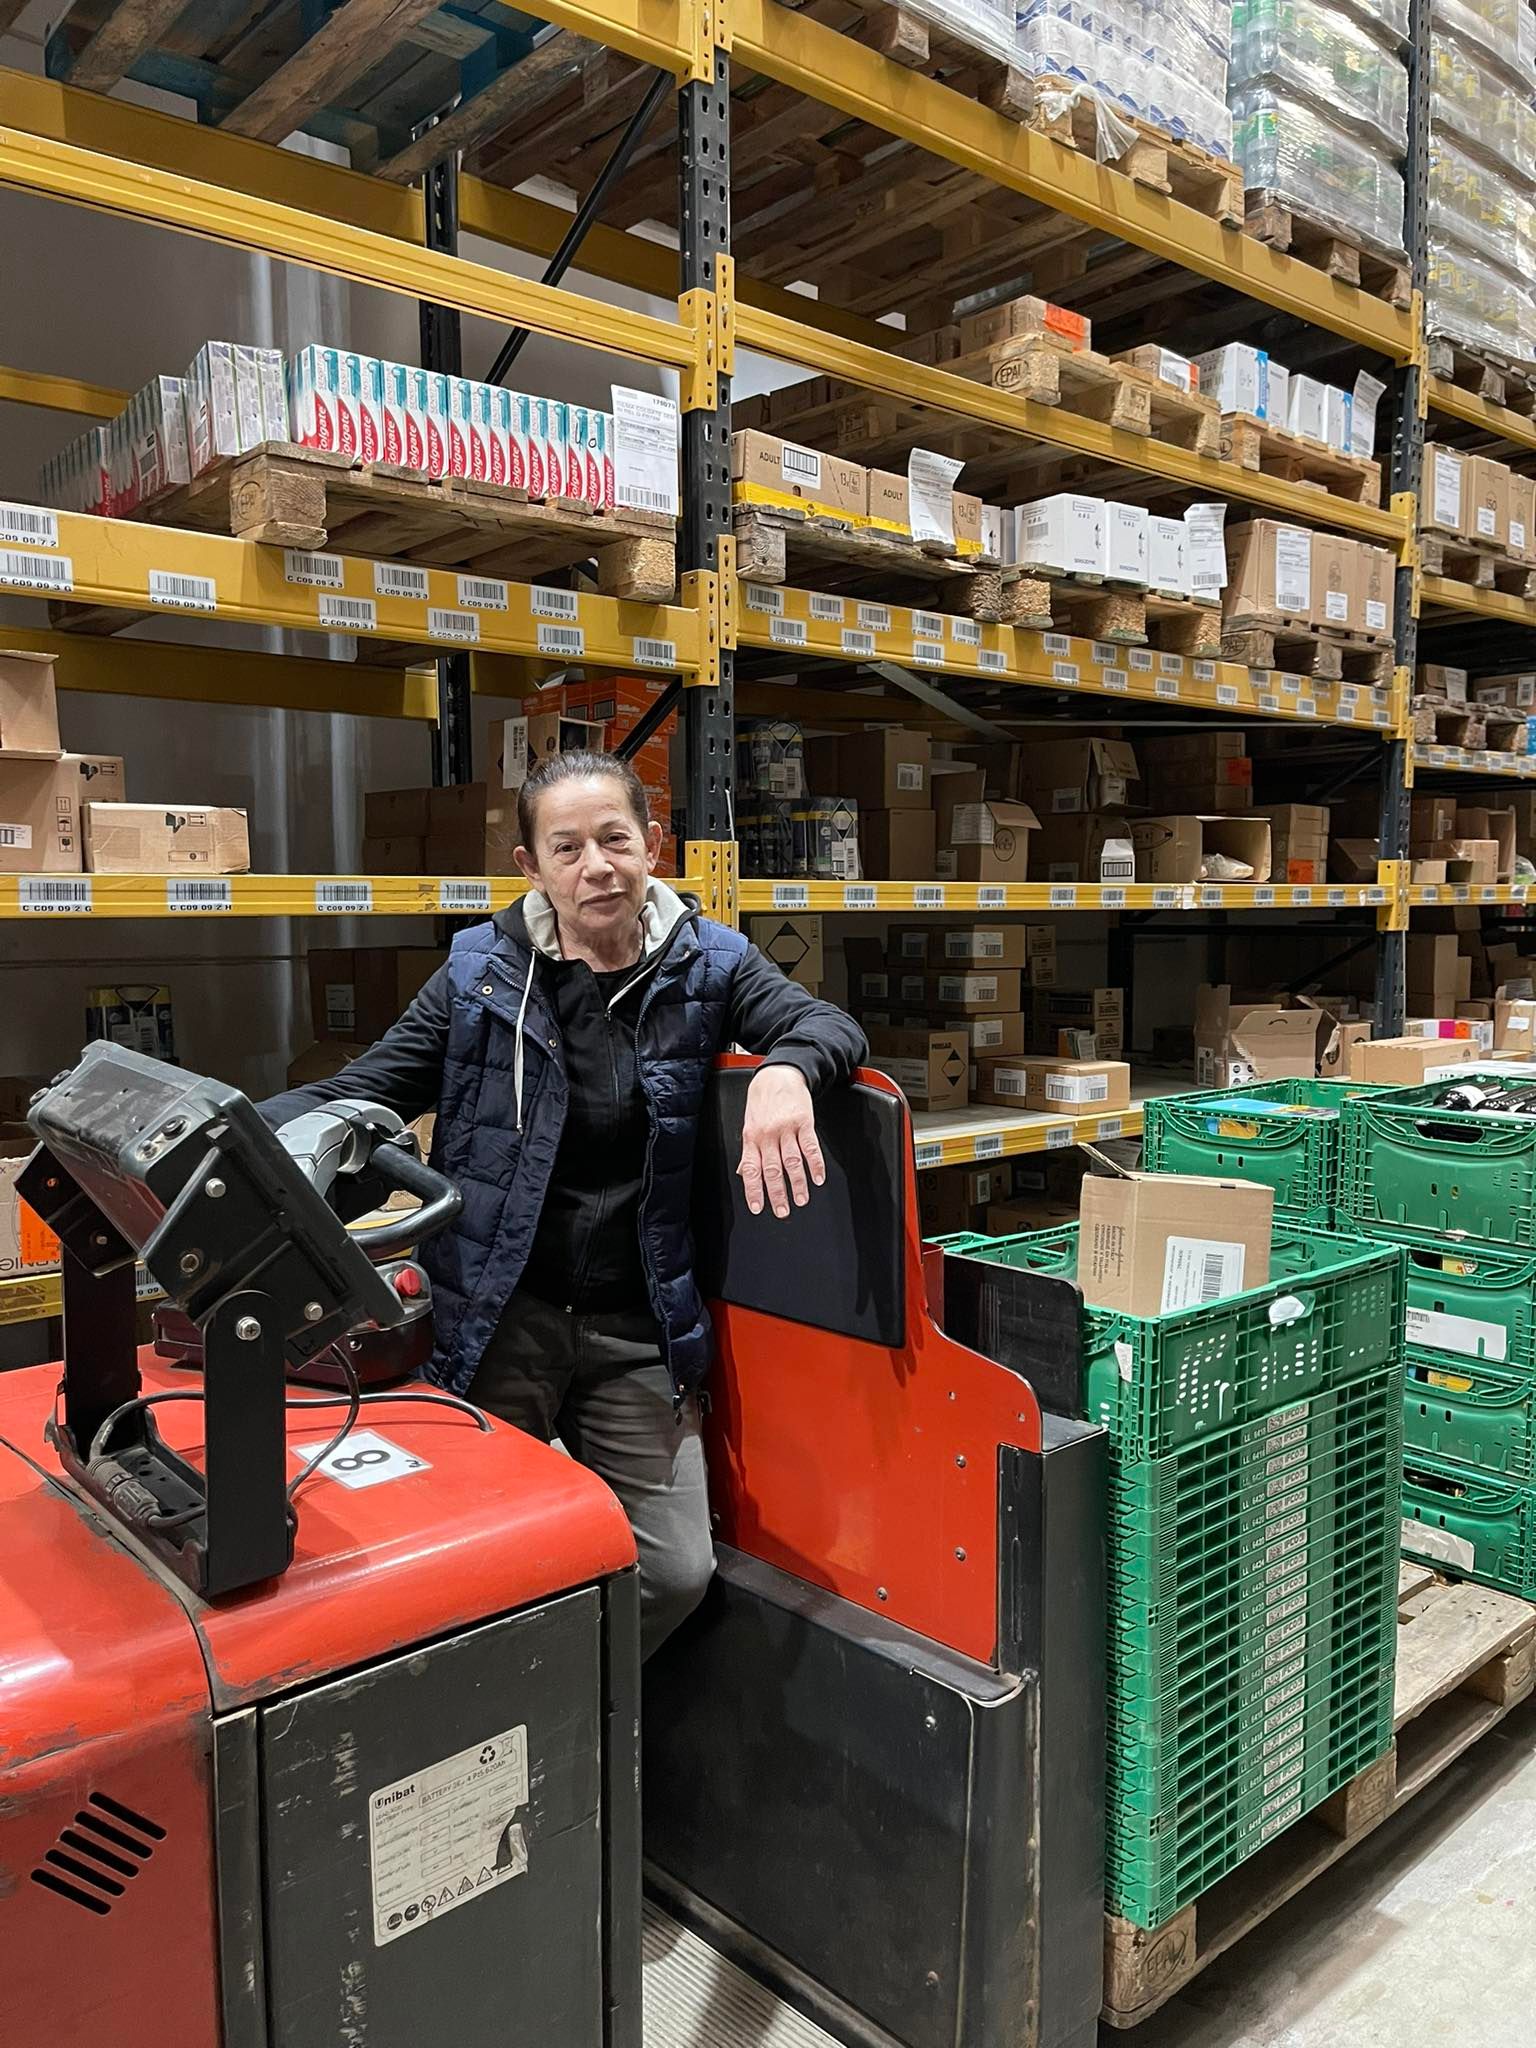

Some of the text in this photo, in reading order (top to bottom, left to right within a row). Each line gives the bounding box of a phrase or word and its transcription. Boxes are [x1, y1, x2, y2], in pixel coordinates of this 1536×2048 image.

[364, 416, 375, 464] Colgate
[430, 429, 440, 476] Colgate
[760, 452, 780, 464] ADULT
[532, 450, 541, 494] Colgate
[550, 454, 559, 497] Colgate
[589, 462, 598, 504] Colgate
[606, 465, 614, 510] Colgate
[883, 489, 902, 501] ADULT
[12, 579, 32, 587] C09
[296, 576, 313, 584] C09
[161, 598, 180, 606] C09
[385, 588, 400, 596] C09
[330, 619, 347, 627] C09
[539, 609, 553, 617] C09
[331, 1449, 391, 1471] 8
[375, 1784, 416, 1809] Unibat
[421, 1784, 450, 1804] BATTERY
